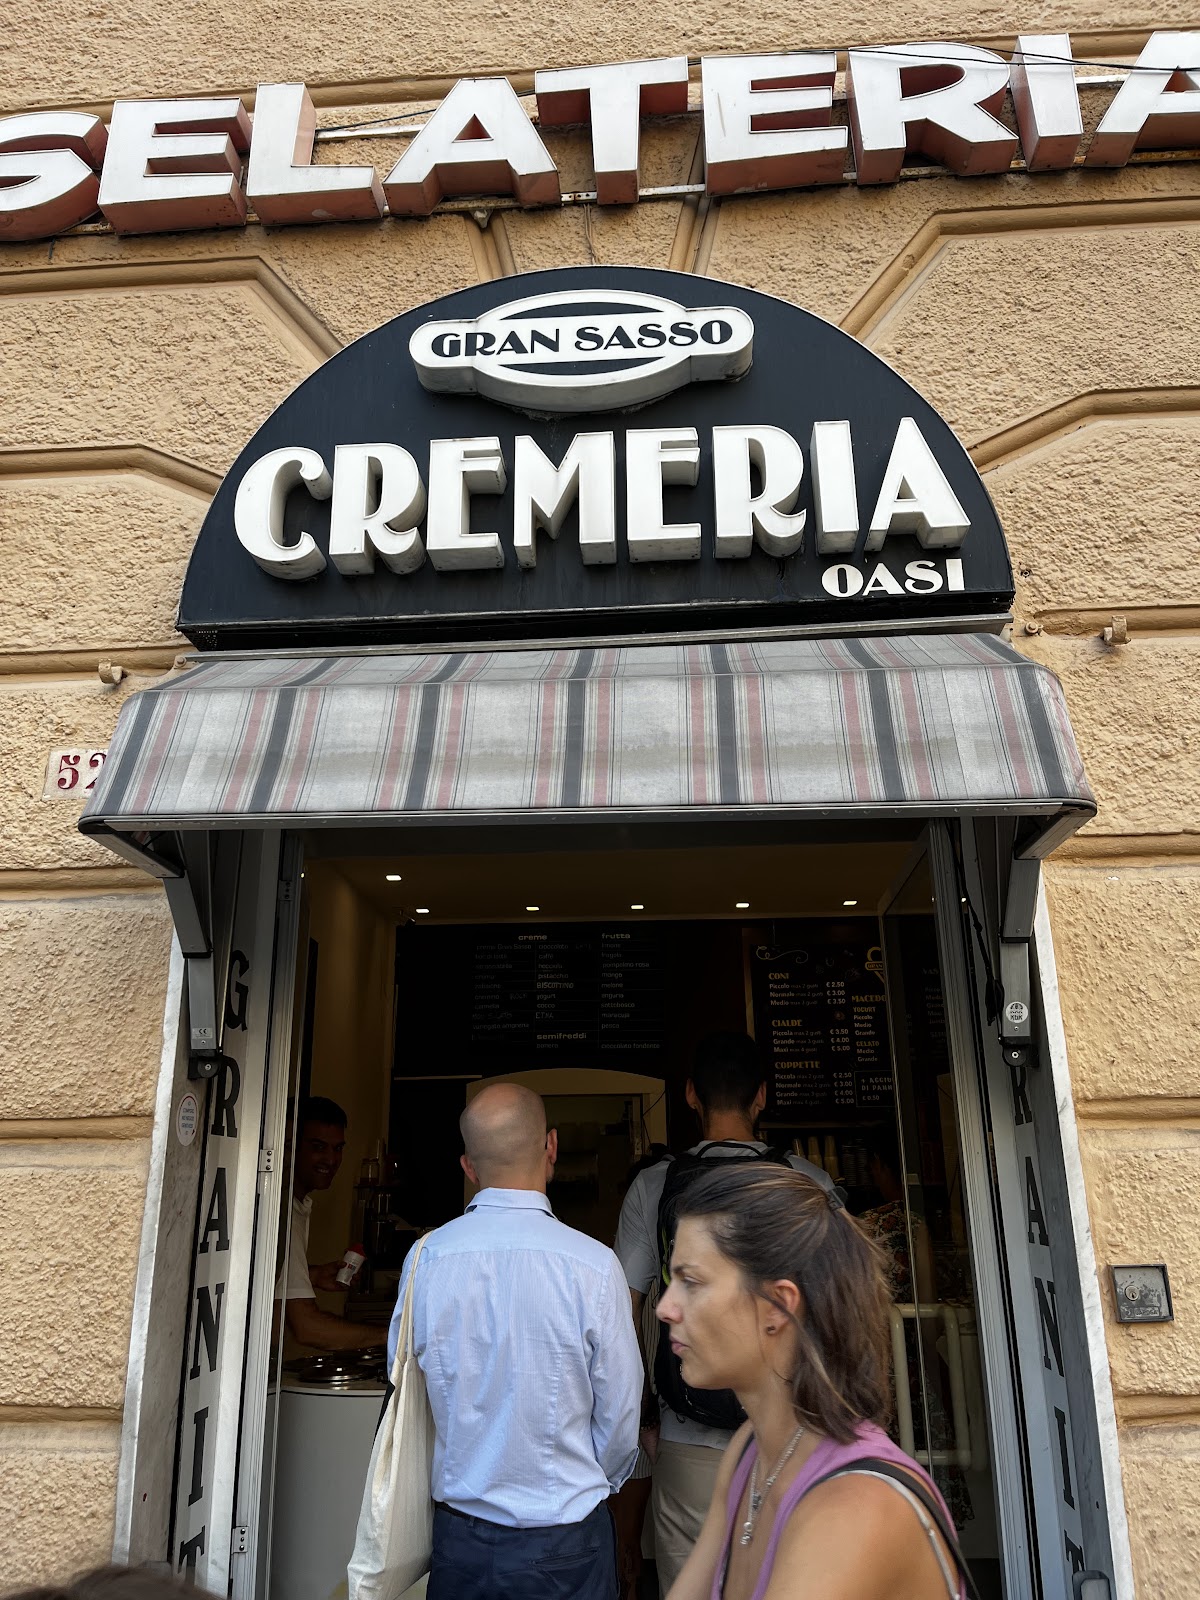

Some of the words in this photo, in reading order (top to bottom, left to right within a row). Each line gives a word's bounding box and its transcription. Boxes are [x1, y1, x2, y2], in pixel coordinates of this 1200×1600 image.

[431, 328, 561, 361] GRAN
[573, 318, 733, 351] SASSO
[234, 416, 971, 581] CREMERIA
[821, 557, 966, 598] OASI
[768, 972, 790, 980] CONI
[771, 1019, 803, 1027] CIALDE
[536, 1032, 587, 1040] semifreddi
[774, 1060, 821, 1070] COPPETTE
